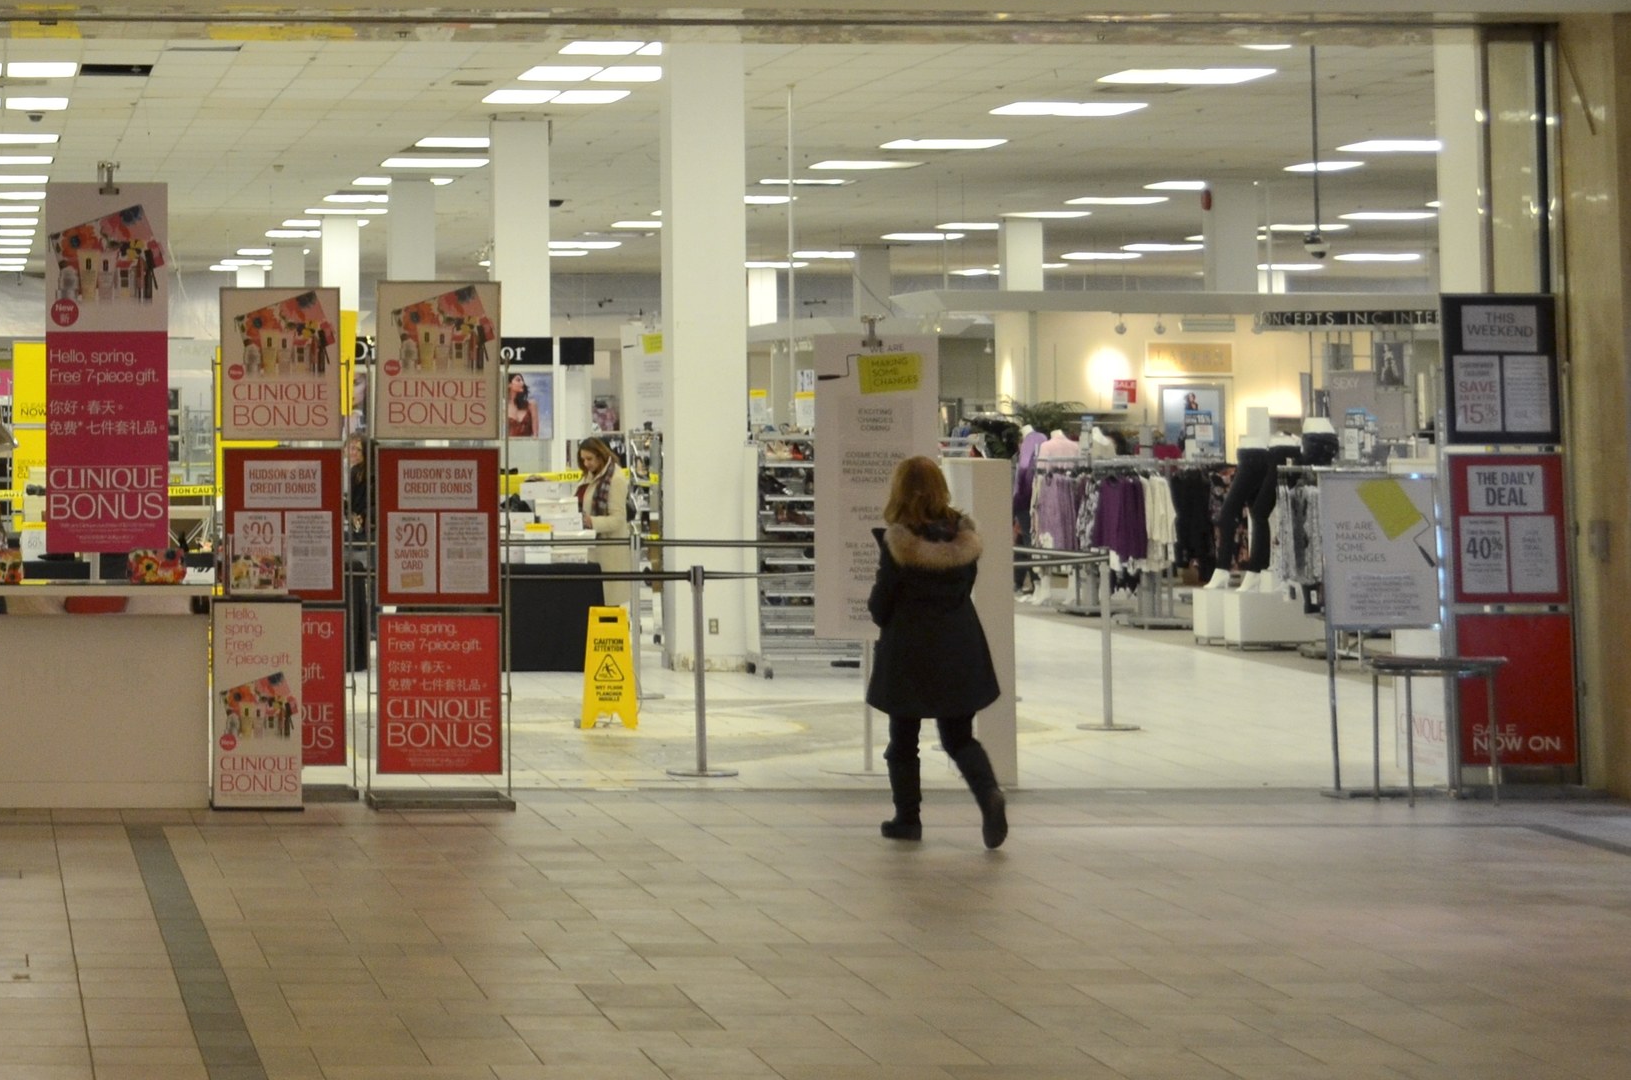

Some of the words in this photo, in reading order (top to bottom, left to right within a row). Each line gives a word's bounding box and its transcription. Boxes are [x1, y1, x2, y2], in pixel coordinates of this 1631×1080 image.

[1259, 311, 1334, 326] ONCEPTS
[1347, 311, 1383, 326] INC
[1484, 311, 1515, 324] THIS
[1466, 324, 1534, 338] WEEKEND
[500, 345, 526, 361] or
[870, 345, 883, 353] WE
[888, 344, 905, 352] ARE
[49, 349, 88, 366] Hello,
[90, 350, 138, 367] spring.
[871, 357, 908, 367] MAKING
[86, 369, 134, 386] 7-piece
[136, 369, 159, 386] gift.
[872, 369, 898, 377] SOME
[873, 375, 919, 387] CHANGES
[1458, 380, 1497, 394] SAVE
[232, 383, 328, 402] CLINIQUE
[388, 379, 487, 401] CLINIQUE
[232, 404, 328, 427] BONUS
[388, 401, 487, 425] BONUS
[49, 467, 164, 492] CLINIQUE
[298, 469, 318, 480] BAY
[454, 468, 474, 480] BAY
[558, 473, 579, 481] TION
[1476, 471, 1498, 486] THE
[1501, 471, 1535, 486] DAILY
[250, 482, 283, 494] CREDIT
[284, 482, 317, 494] BONUS
[404, 482, 438, 494] CREDIT
[440, 482, 473, 494] BONUS
[1485, 487, 1528, 507] DEAL
[49, 493, 164, 520] BONUS
[242, 521, 274, 545] $20
[1335, 522, 1351, 531] WE
[1354, 521, 1373, 530] ARE
[395, 523, 428, 547] $20
[1335, 532, 1377, 542] MAKING
[394, 548, 429, 559] SAVINGS
[1336, 542, 1364, 552] SOME
[401, 560, 424, 570] CARD
[1336, 553, 1387, 563] CHANGES
[225, 608, 258, 621] Hello,
[225, 623, 265, 636] spring.
[387, 621, 419, 634] Hello,
[420, 622, 458, 636] spring.
[419, 638, 460, 653] 7-piece
[462, 638, 482, 654] gift.
[226, 654, 269, 667] 7-piece
[271, 653, 292, 667] gift.
[387, 699, 492, 721] CLINIQUE
[387, 723, 493, 748] BONUS
[1528, 736, 1562, 752] ON
[220, 756, 298, 773] CLINIQUE
[220, 774, 298, 793] BONUS
